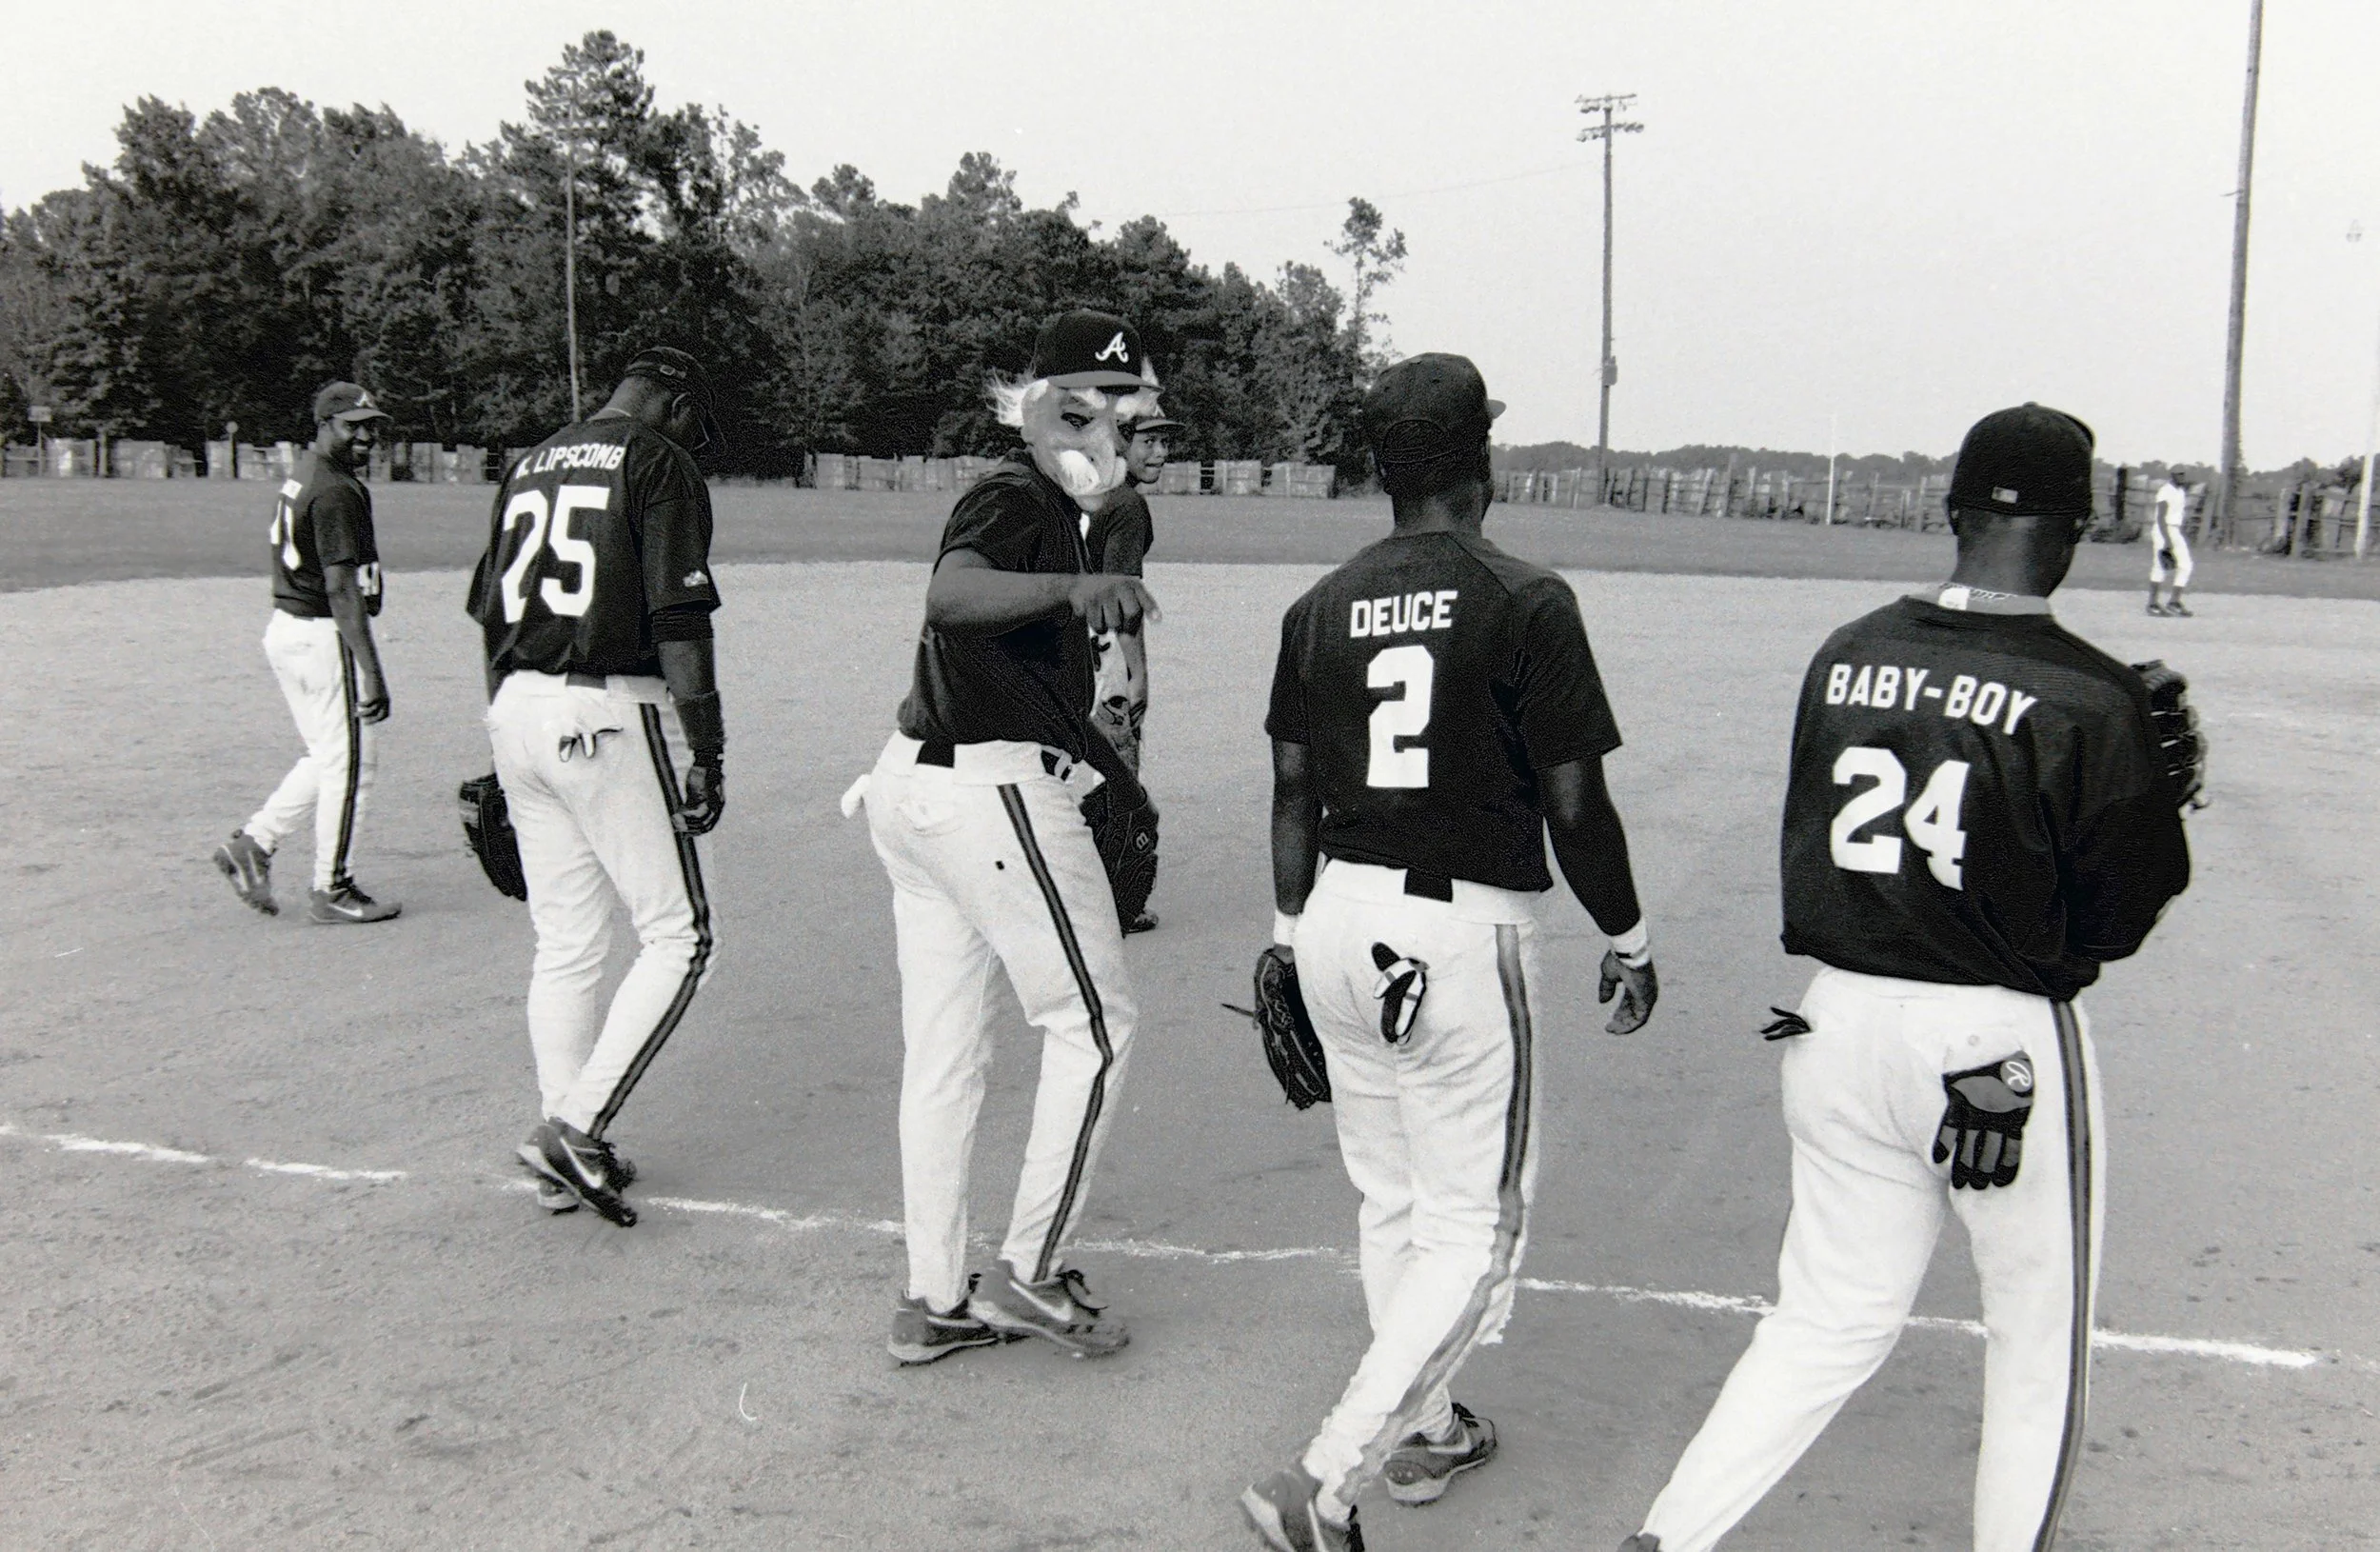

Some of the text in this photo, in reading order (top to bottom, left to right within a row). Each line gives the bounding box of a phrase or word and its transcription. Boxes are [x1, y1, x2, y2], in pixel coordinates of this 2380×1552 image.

[1095, 331, 1129, 363] A
[533, 443, 627, 473] LIPSCOMB
[501, 484, 610, 624] 25
[1350, 590, 1458, 638] DEUCE
[1366, 645, 1435, 788] 2
[1826, 664, 2038, 735] BABY-BOY
[1830, 746, 1971, 891] 24
